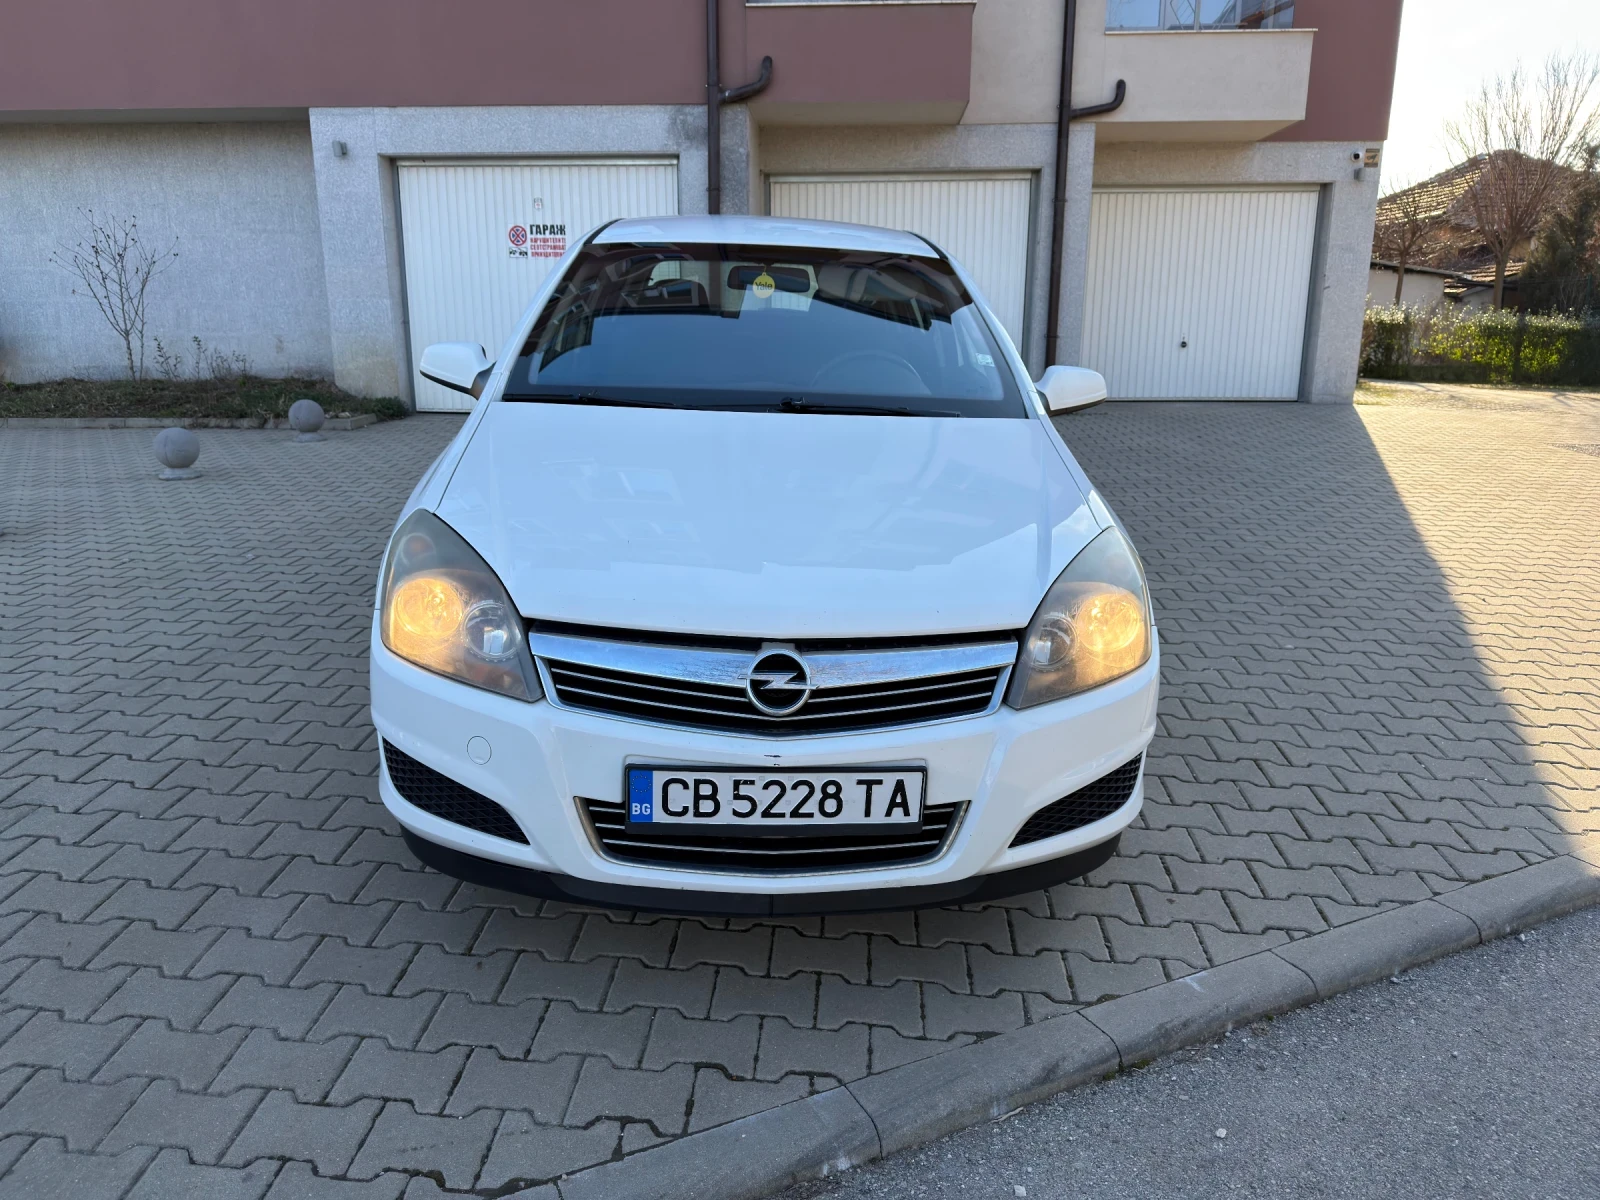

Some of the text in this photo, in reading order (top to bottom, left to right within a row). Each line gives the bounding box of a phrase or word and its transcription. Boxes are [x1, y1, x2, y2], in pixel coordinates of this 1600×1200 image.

[530, 224, 566, 235] ГАРАЖ
[755, 282, 772, 290] Yale
[661, 778, 911, 818] CB 5228 TA
[632, 803, 650, 814] BG
